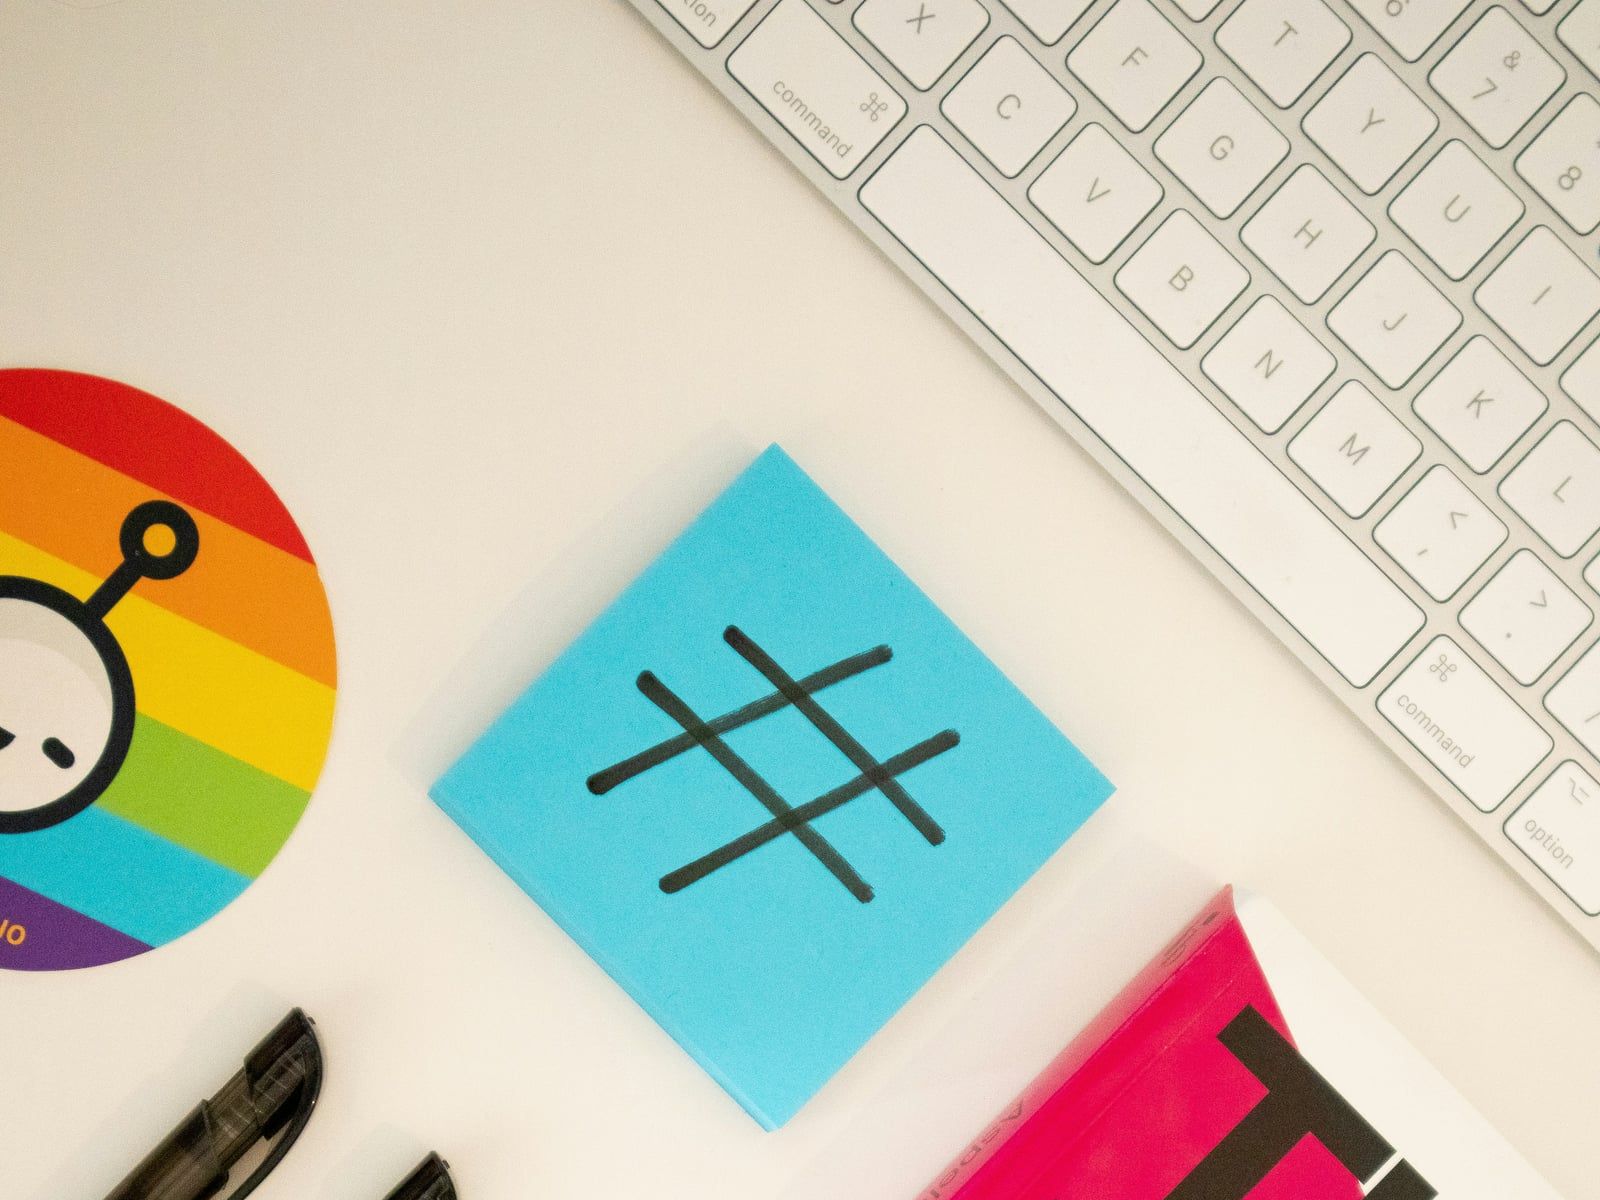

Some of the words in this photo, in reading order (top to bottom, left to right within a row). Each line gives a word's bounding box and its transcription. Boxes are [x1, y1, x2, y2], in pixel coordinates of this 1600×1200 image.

[905, 3, 936, 34] X
[1273, 20, 1298, 47] T
[1121, 46, 1149, 67] F
[1503, 50, 1521, 72] &
[1472, 76, 1498, 100] 7
[772, 79, 854, 159] command
[996, 93, 1022, 120] C
[1360, 107, 1386, 133] Y
[1208, 135, 1235, 161] G
[1086, 177, 1112, 204] V
[1558, 165, 1582, 191] 8
[1444, 194, 1471, 223] U
[1293, 218, 1323, 249] H
[1168, 264, 1194, 292] B
[1382, 312, 1408, 332] J
[1253, 349, 1284, 380] N
[1465, 389, 1495, 419] K
[1337, 432, 1371, 466] M
[1552, 475, 1573, 504] L
[1396, 694, 1476, 769] command
[586, 624, 961, 904] #
[1524, 818, 1575, 870] option
